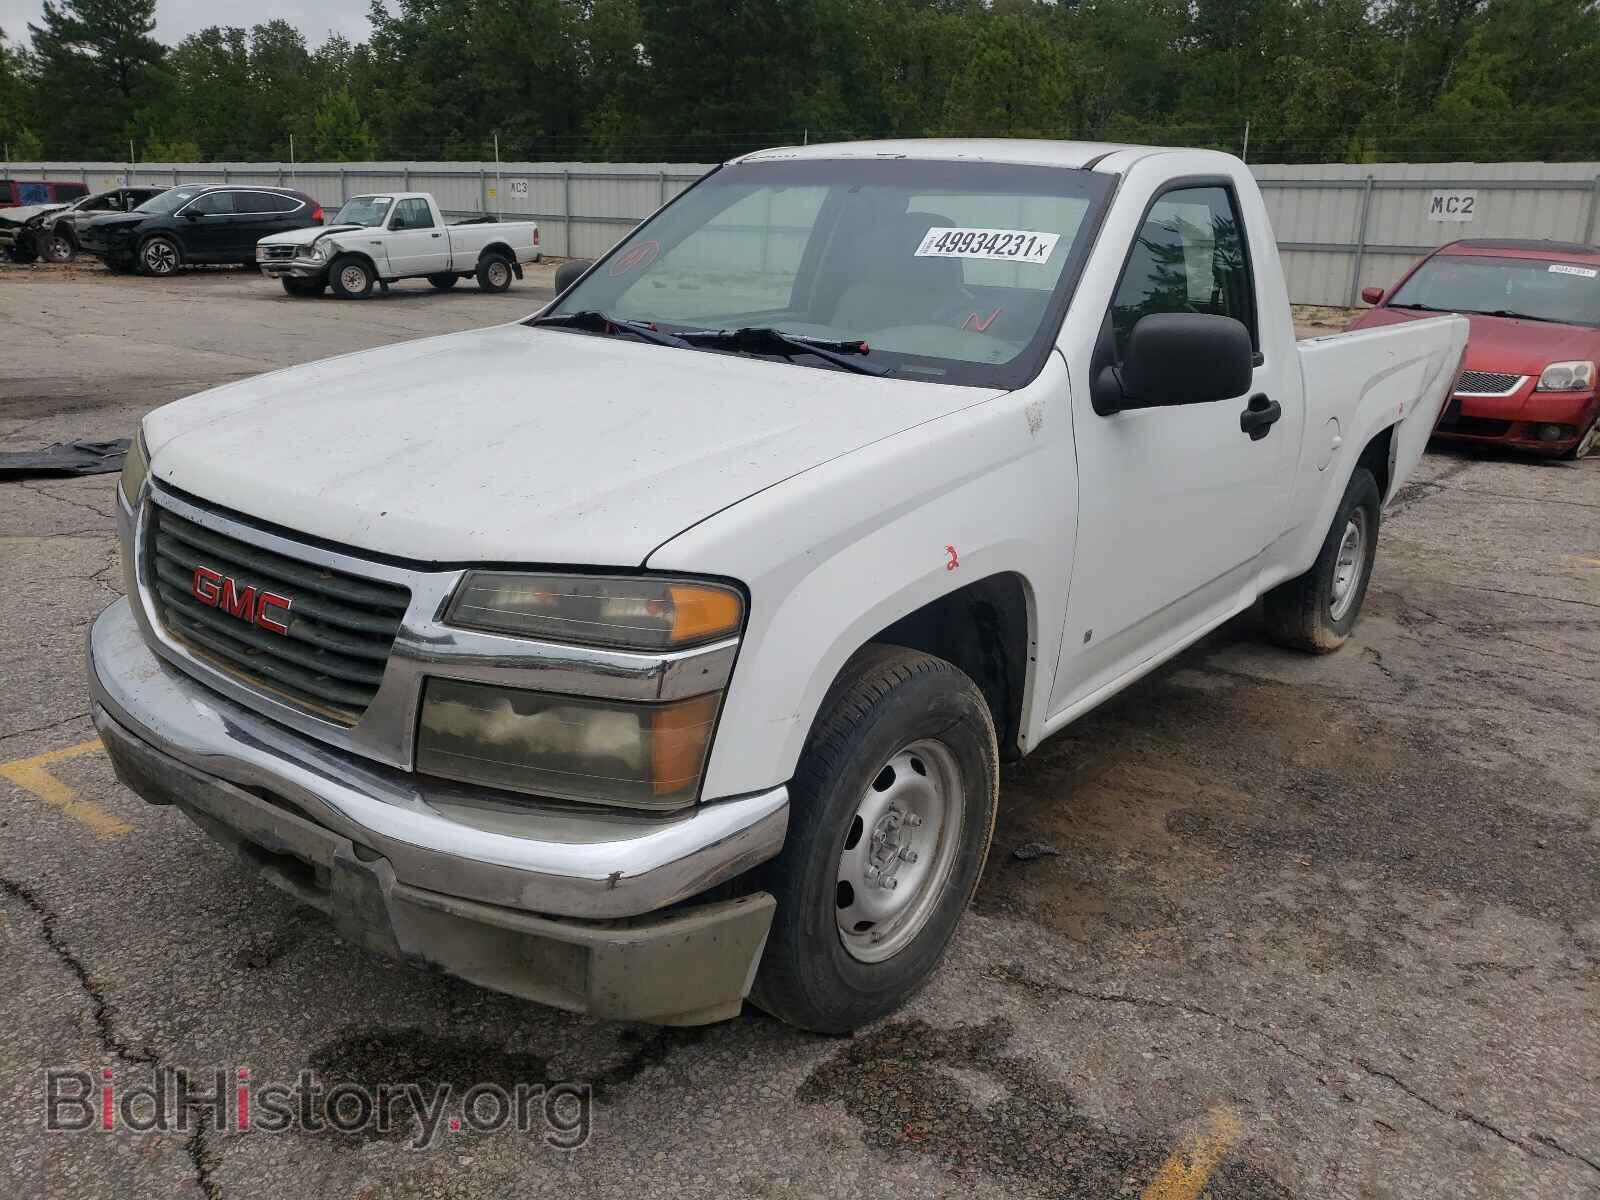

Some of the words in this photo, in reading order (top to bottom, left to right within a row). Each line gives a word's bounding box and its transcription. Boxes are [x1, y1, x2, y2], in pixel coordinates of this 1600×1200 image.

[1431, 196, 1474, 214] MC2
[944, 544, 959, 571] 2
[192, 565, 292, 636] GMC
